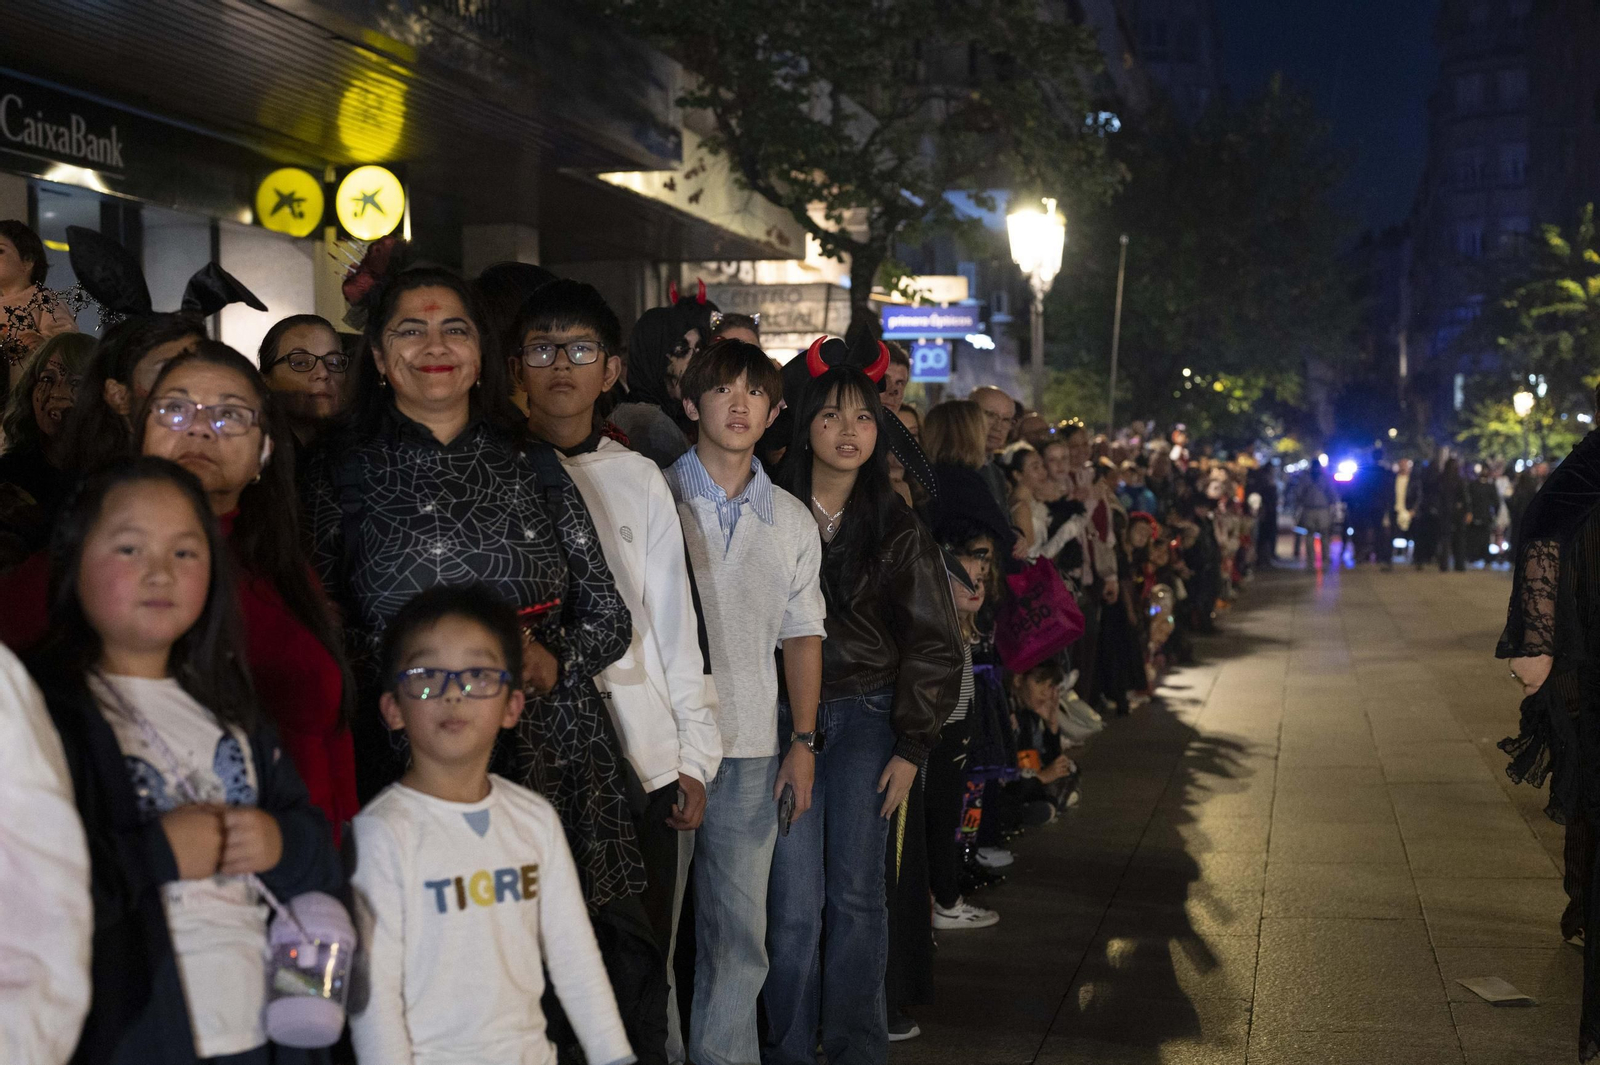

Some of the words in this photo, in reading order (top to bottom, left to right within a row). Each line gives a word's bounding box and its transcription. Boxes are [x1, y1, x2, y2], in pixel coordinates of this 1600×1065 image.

[0, 94, 124, 168] CaixaBank
[914, 348, 947, 376] po
[424, 863, 539, 914] TIGRE
